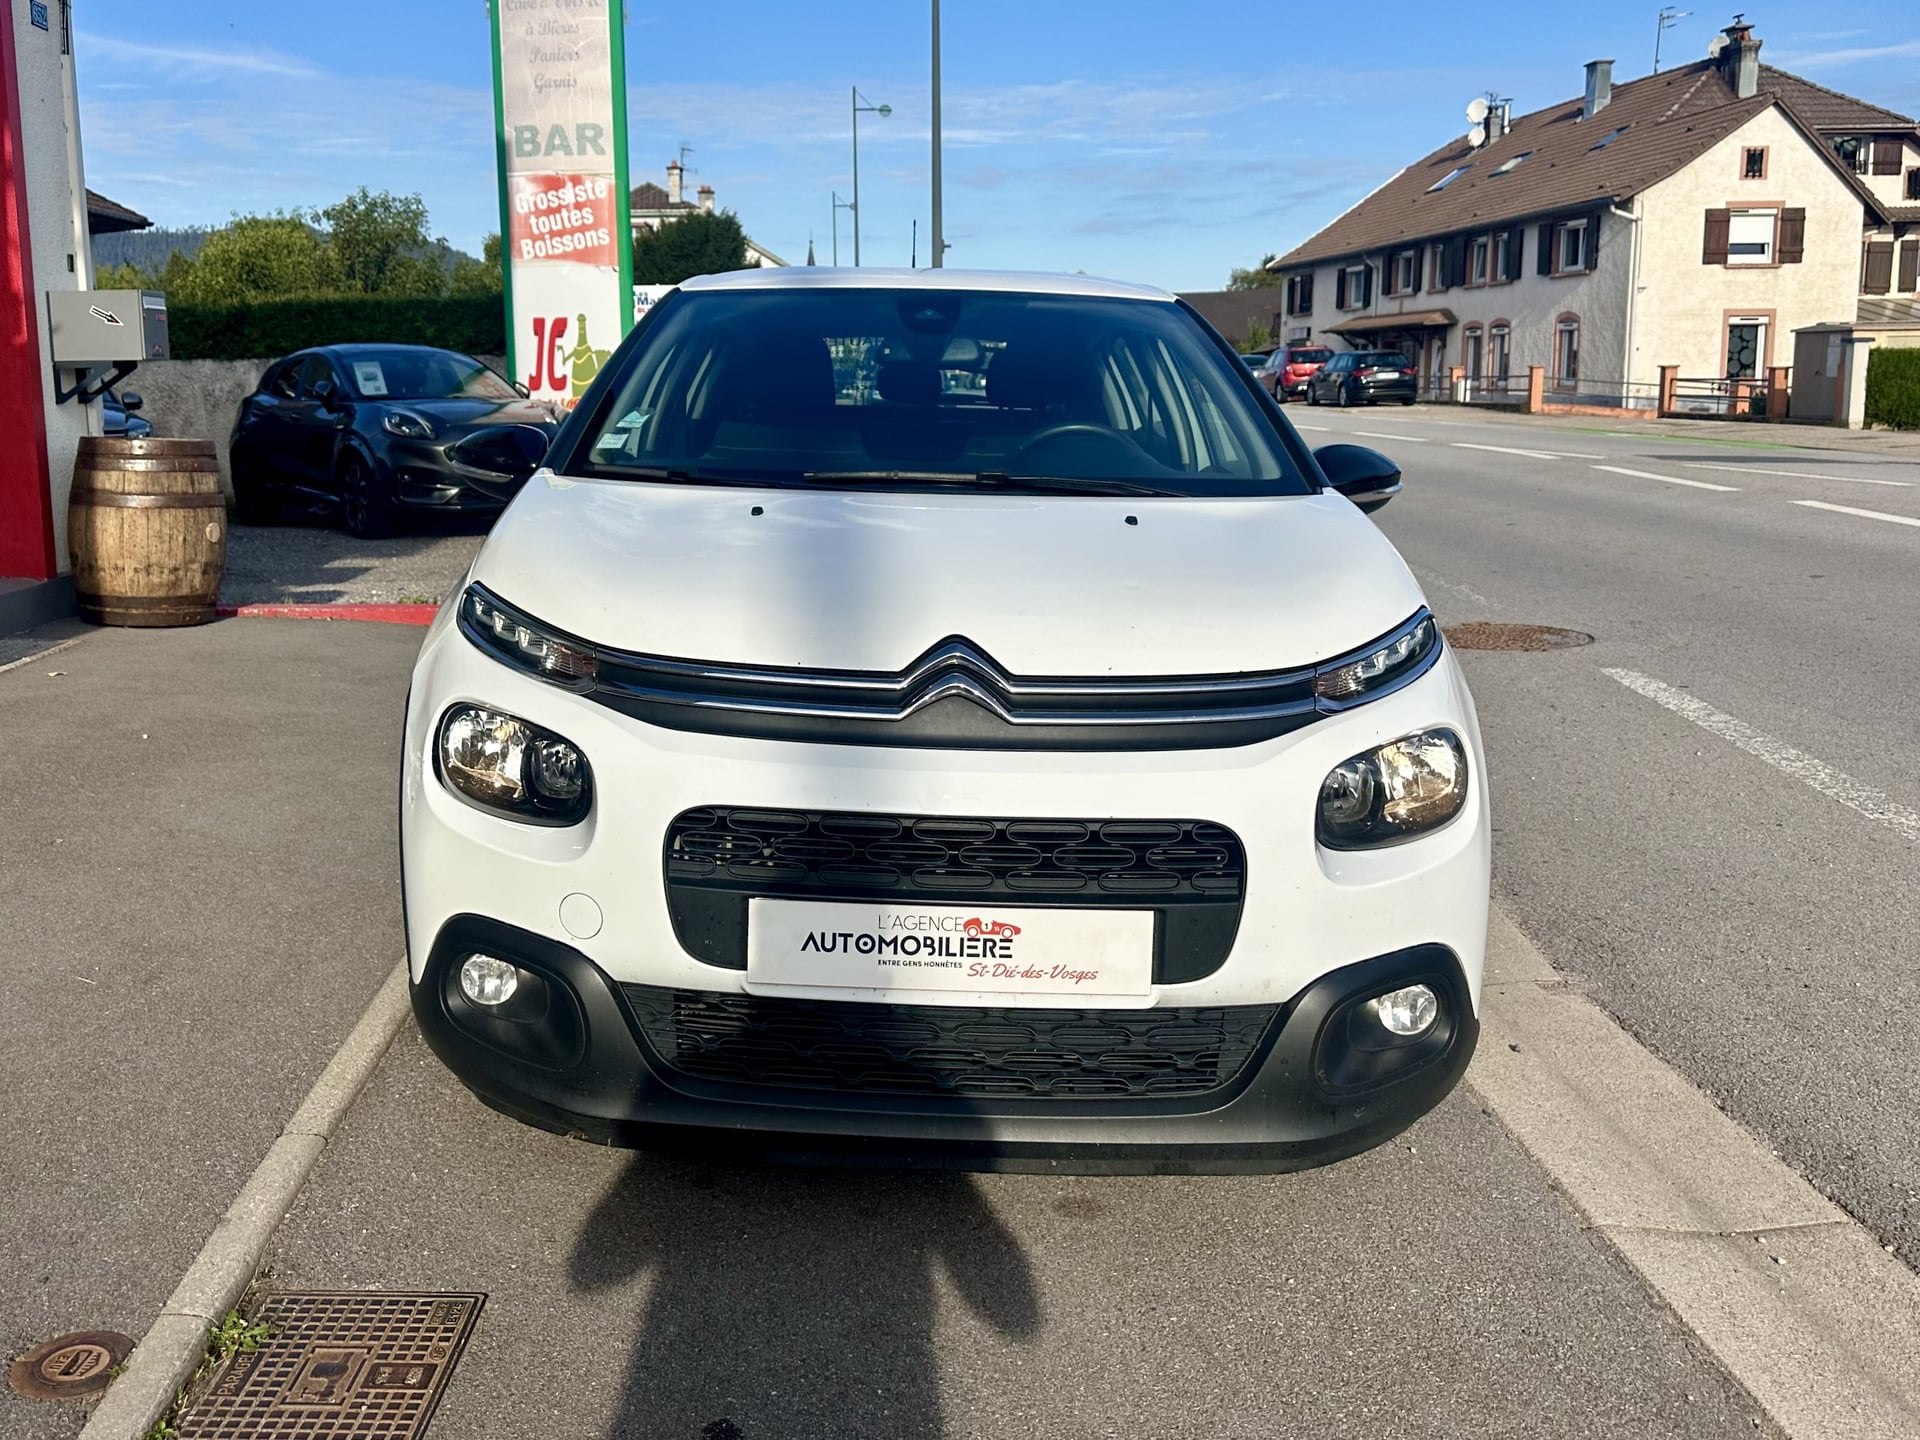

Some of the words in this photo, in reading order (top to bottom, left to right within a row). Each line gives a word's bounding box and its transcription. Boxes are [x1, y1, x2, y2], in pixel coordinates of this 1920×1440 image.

[529, 47, 580, 63] Paniers
[533, 73, 578, 94] Garnis
[514, 122, 607, 158] BAR
[515, 179, 608, 214] Grossiste
[529, 207, 594, 235] toutes
[520, 227, 611, 261] Boissons
[528, 317, 568, 391] JC
[877, 913, 964, 933] L'AGENCE
[923, 960, 963, 968] HONNÊTES
[966, 962, 1099, 985] St-Dié-des-Vosges
[216, 1350, 258, 1395] PARAGEL
